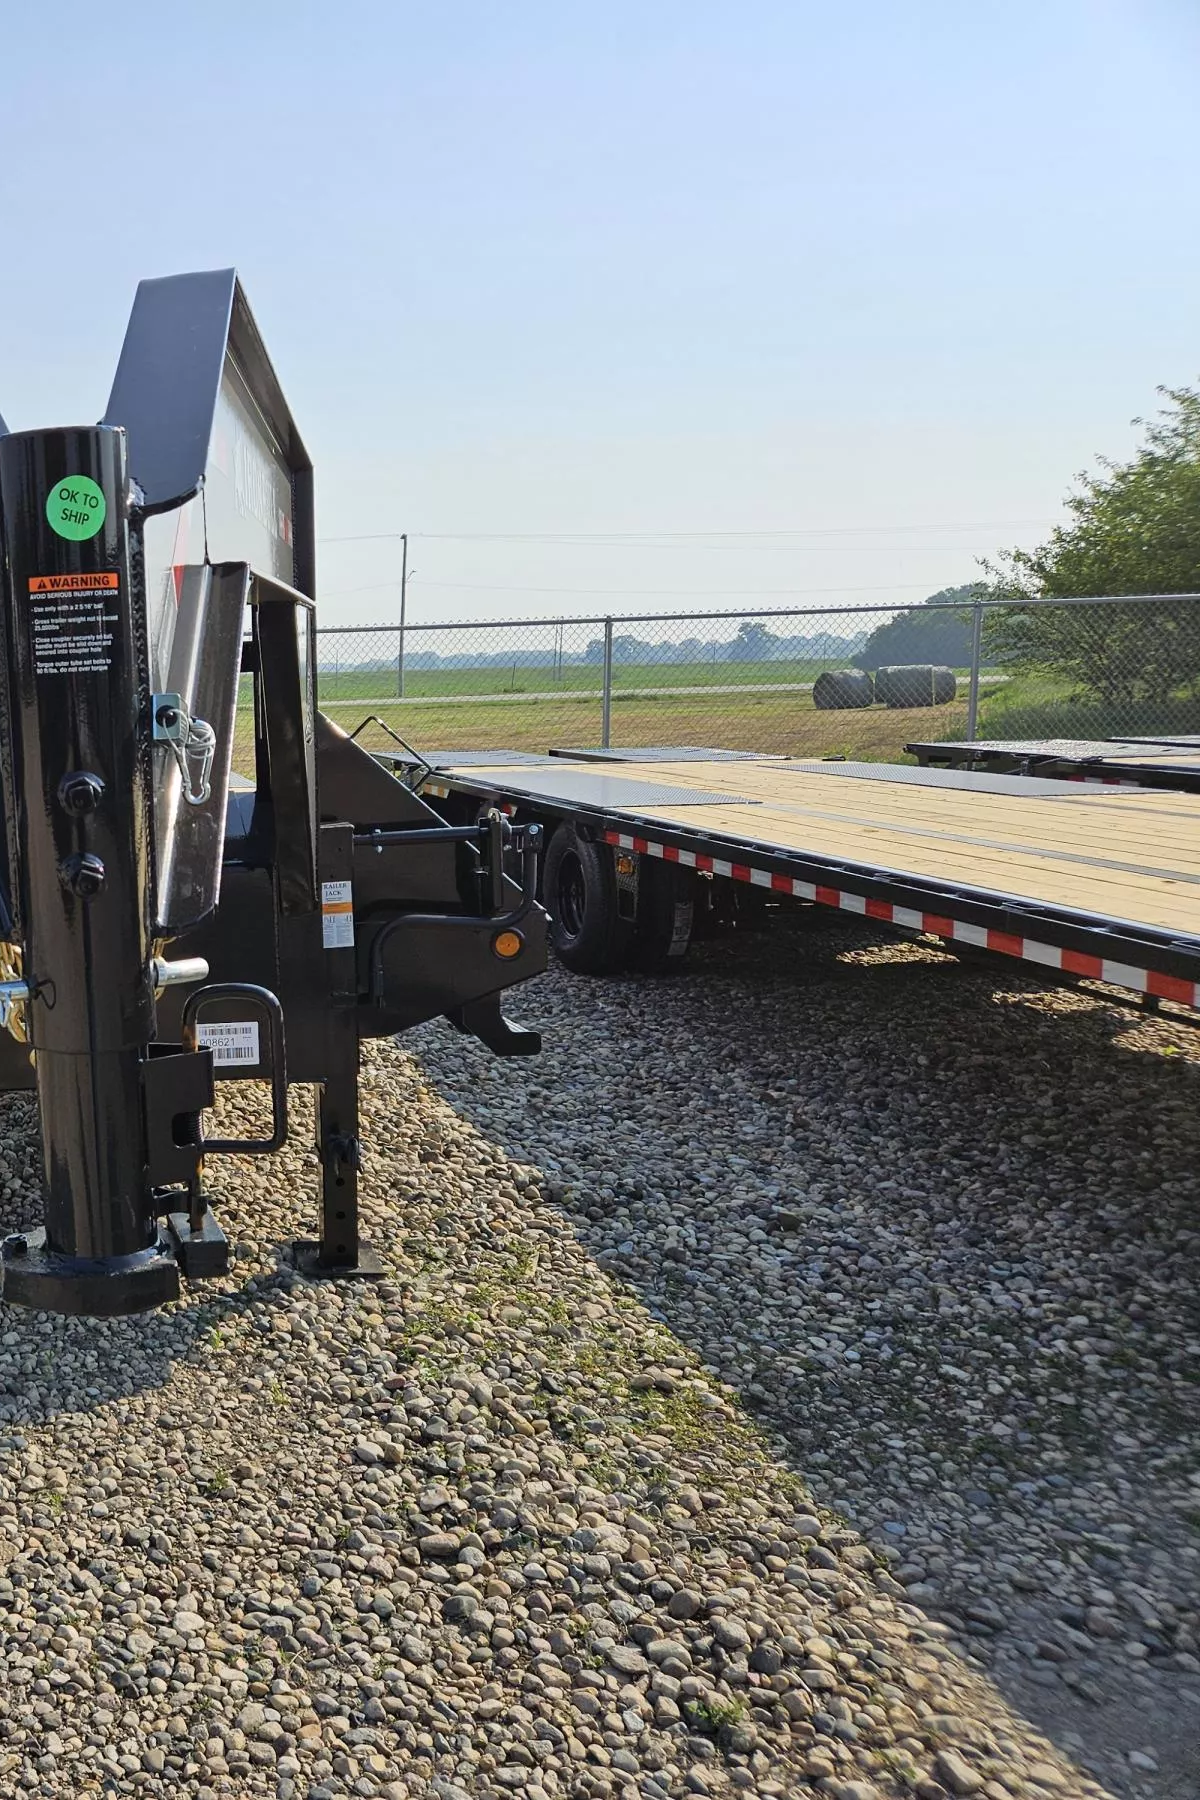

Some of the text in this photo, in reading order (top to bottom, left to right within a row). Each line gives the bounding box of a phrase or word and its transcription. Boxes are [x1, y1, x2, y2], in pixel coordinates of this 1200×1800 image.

[59, 488, 98, 508] OK TO
[61, 508, 89, 525] SHIP
[50, 576, 110, 588] WARNING
